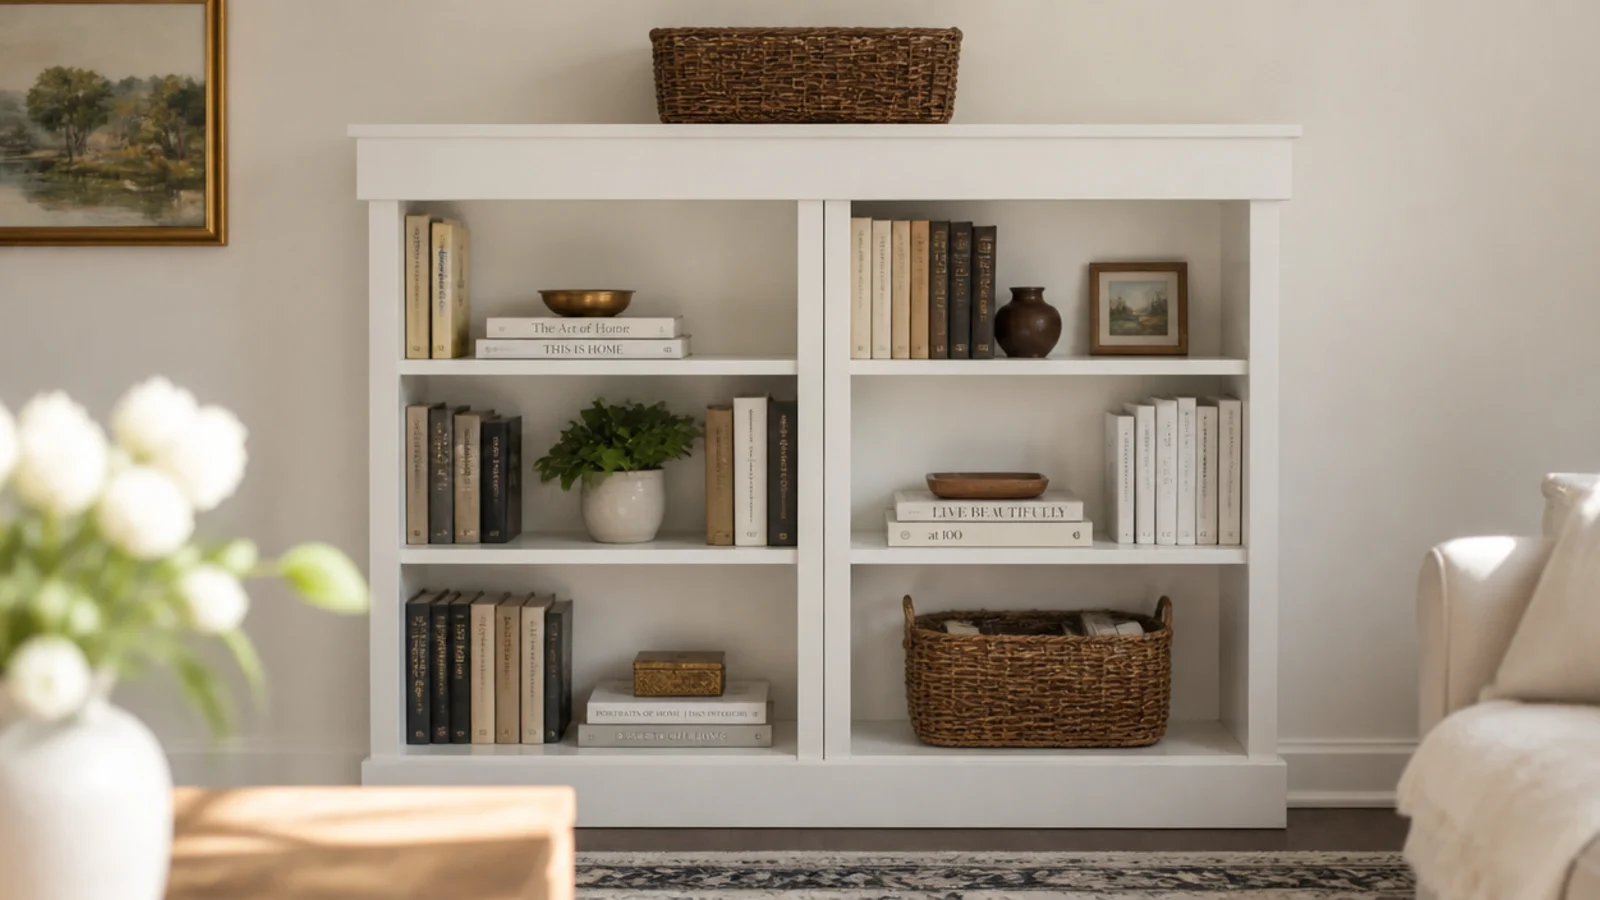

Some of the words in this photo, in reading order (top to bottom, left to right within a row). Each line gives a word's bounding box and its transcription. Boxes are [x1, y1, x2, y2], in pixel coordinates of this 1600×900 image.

[532, 322, 555, 333] The
[558, 323, 577, 333] Art
[580, 322, 593, 333] of
[543, 344, 571, 354] THIS
[574, 344, 585, 354] IS
[588, 344, 624, 354] HOME
[933, 507, 967, 518] LIVE
[971, 506, 1067, 518] BEAUTIFULLY
[928, 531, 939, 540] at
[942, 530, 963, 540] 100
